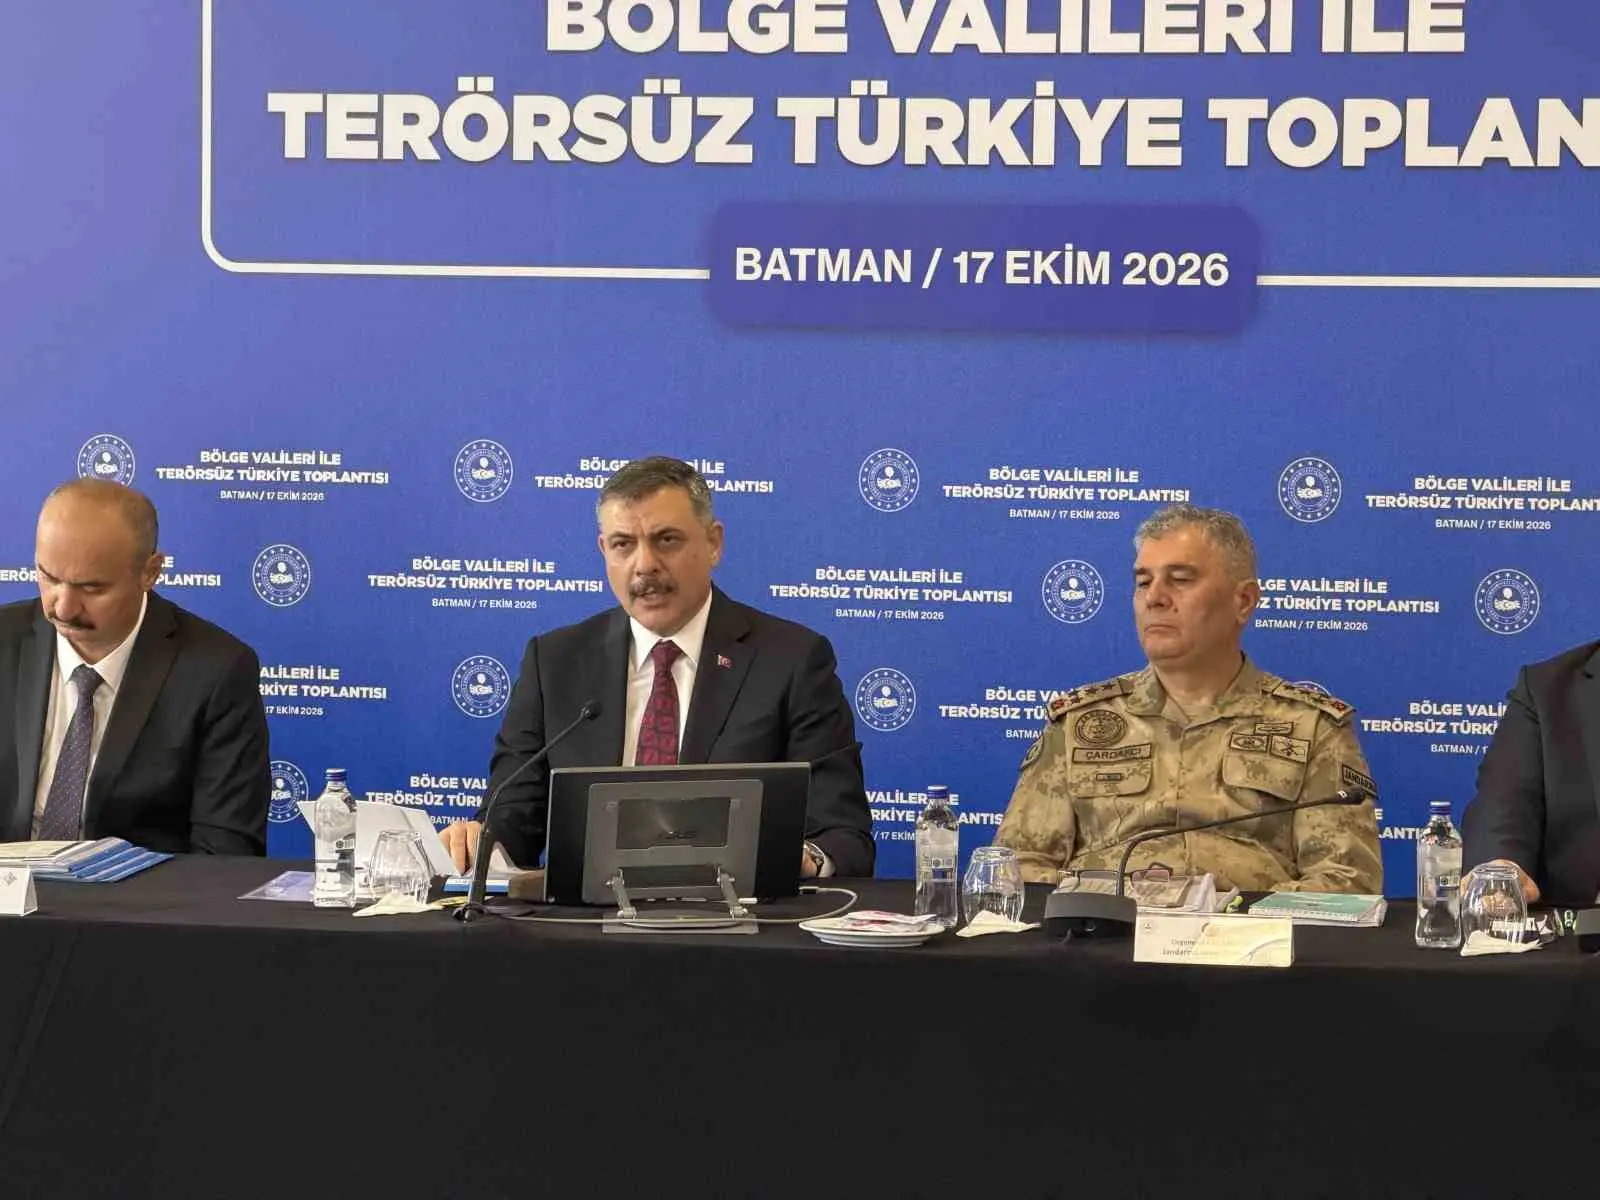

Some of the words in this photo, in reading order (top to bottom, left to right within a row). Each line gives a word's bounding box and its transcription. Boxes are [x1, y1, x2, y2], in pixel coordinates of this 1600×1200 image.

[268, 76, 754, 163] TERÖRSÜZ
[777, 79, 1183, 166] TÜRKİYE
[1208, 97, 1600, 168] TOPLAN
[735, 246, 912, 283] BATMAN
[922, 246, 943, 289] /
[953, 251, 995, 284] 17
[1006, 244, 1110, 285] EKİM
[1123, 251, 1229, 287] 2026
[201, 449, 249, 465] BÖLGE
[252, 449, 316, 465] VALİLERİ
[320, 451, 342, 466] İLE
[702, 458, 725, 473] İLE
[156, 466, 235, 481] TERÖRSÜZ
[237, 467, 301, 482] TÜRKİYE
[303, 470, 389, 484] TOPLANTISI
[989, 465, 1041, 481] BÖLGE
[1044, 467, 1112, 483] VALİLERİ
[1116, 467, 1139, 483] İLE
[535, 473, 609, 489] TERÖRSÜ
[705, 478, 774, 493] PLANTISI
[1414, 474, 1468, 491] BÖLGE
[1471, 476, 1543, 492] VALİLERİ
[1547, 476, 1571, 493] İLE
[220, 490, 259, 500] BATMAN
[943, 483, 1025, 499] TERÖRSÜZ
[1028, 484, 1095, 501] TÜRKİYE
[1098, 488, 1190, 502] TOPLANTISI
[1365, 492, 1452, 509] TERÖRSÜZ
[1455, 493, 1525, 511] TÜRKİYE
[1528, 497, 1600, 512] TOPLANT
[1009, 508, 1051, 518] BATMAN
[1435, 518, 1478, 529] BATMAN
[413, 557, 461, 572] BÖLGE
[465, 557, 530, 573] VALİLERİ
[533, 558, 555, 574] İLE
[154, 574, 221, 587] PLANTISI
[368, 572, 446, 589] TERÖRSÜZ
[449, 574, 513, 590] TÜRKİYE
[516, 578, 604, 593] TOPLANTISI
[816, 565, 866, 582] BÖLGE
[869, 567, 937, 583] VALİLERİ
[940, 568, 963, 584] İLE
[769, 583, 851, 599] TERÖRSÜZ
[854, 584, 919, 601] TÜRKİYE
[922, 588, 1013, 603] TOPLANTISI
[1257, 578, 1287, 592] LGE
[1290, 578, 1360, 593] VALİLERİ
[1364, 578, 1388, 594] İLE
[432, 597, 471, 608] BATMAN
[1274, 594, 1342, 611] TÜRKİYE
[1345, 599, 1440, 613] TOPLANTISI
[835, 608, 876, 618] BATMAN
[1255, 619, 1297, 629] BATMAN
[260, 665, 315, 680] ALİLERİ
[318, 665, 340, 681] İLE
[259, 681, 298, 697] RKİYE
[301, 684, 387, 699] TOPLANTISI
[986, 686, 1037, 702] BÖLGE
[938, 703, 1021, 720] TERÖRSÜZ
[1409, 699, 1463, 716] BÖLGE
[1466, 702, 1508, 717] VALİ
[1360, 717, 1447, 734] TERÖRSÜZ
[1449, 719, 1499, 736] TÜRKİ
[1431, 743, 1474, 754] BATMAN
[410, 773, 459, 789] BÖLGE
[866, 788, 928, 805] VALİLER
[870, 806, 915, 822] RKİYE
